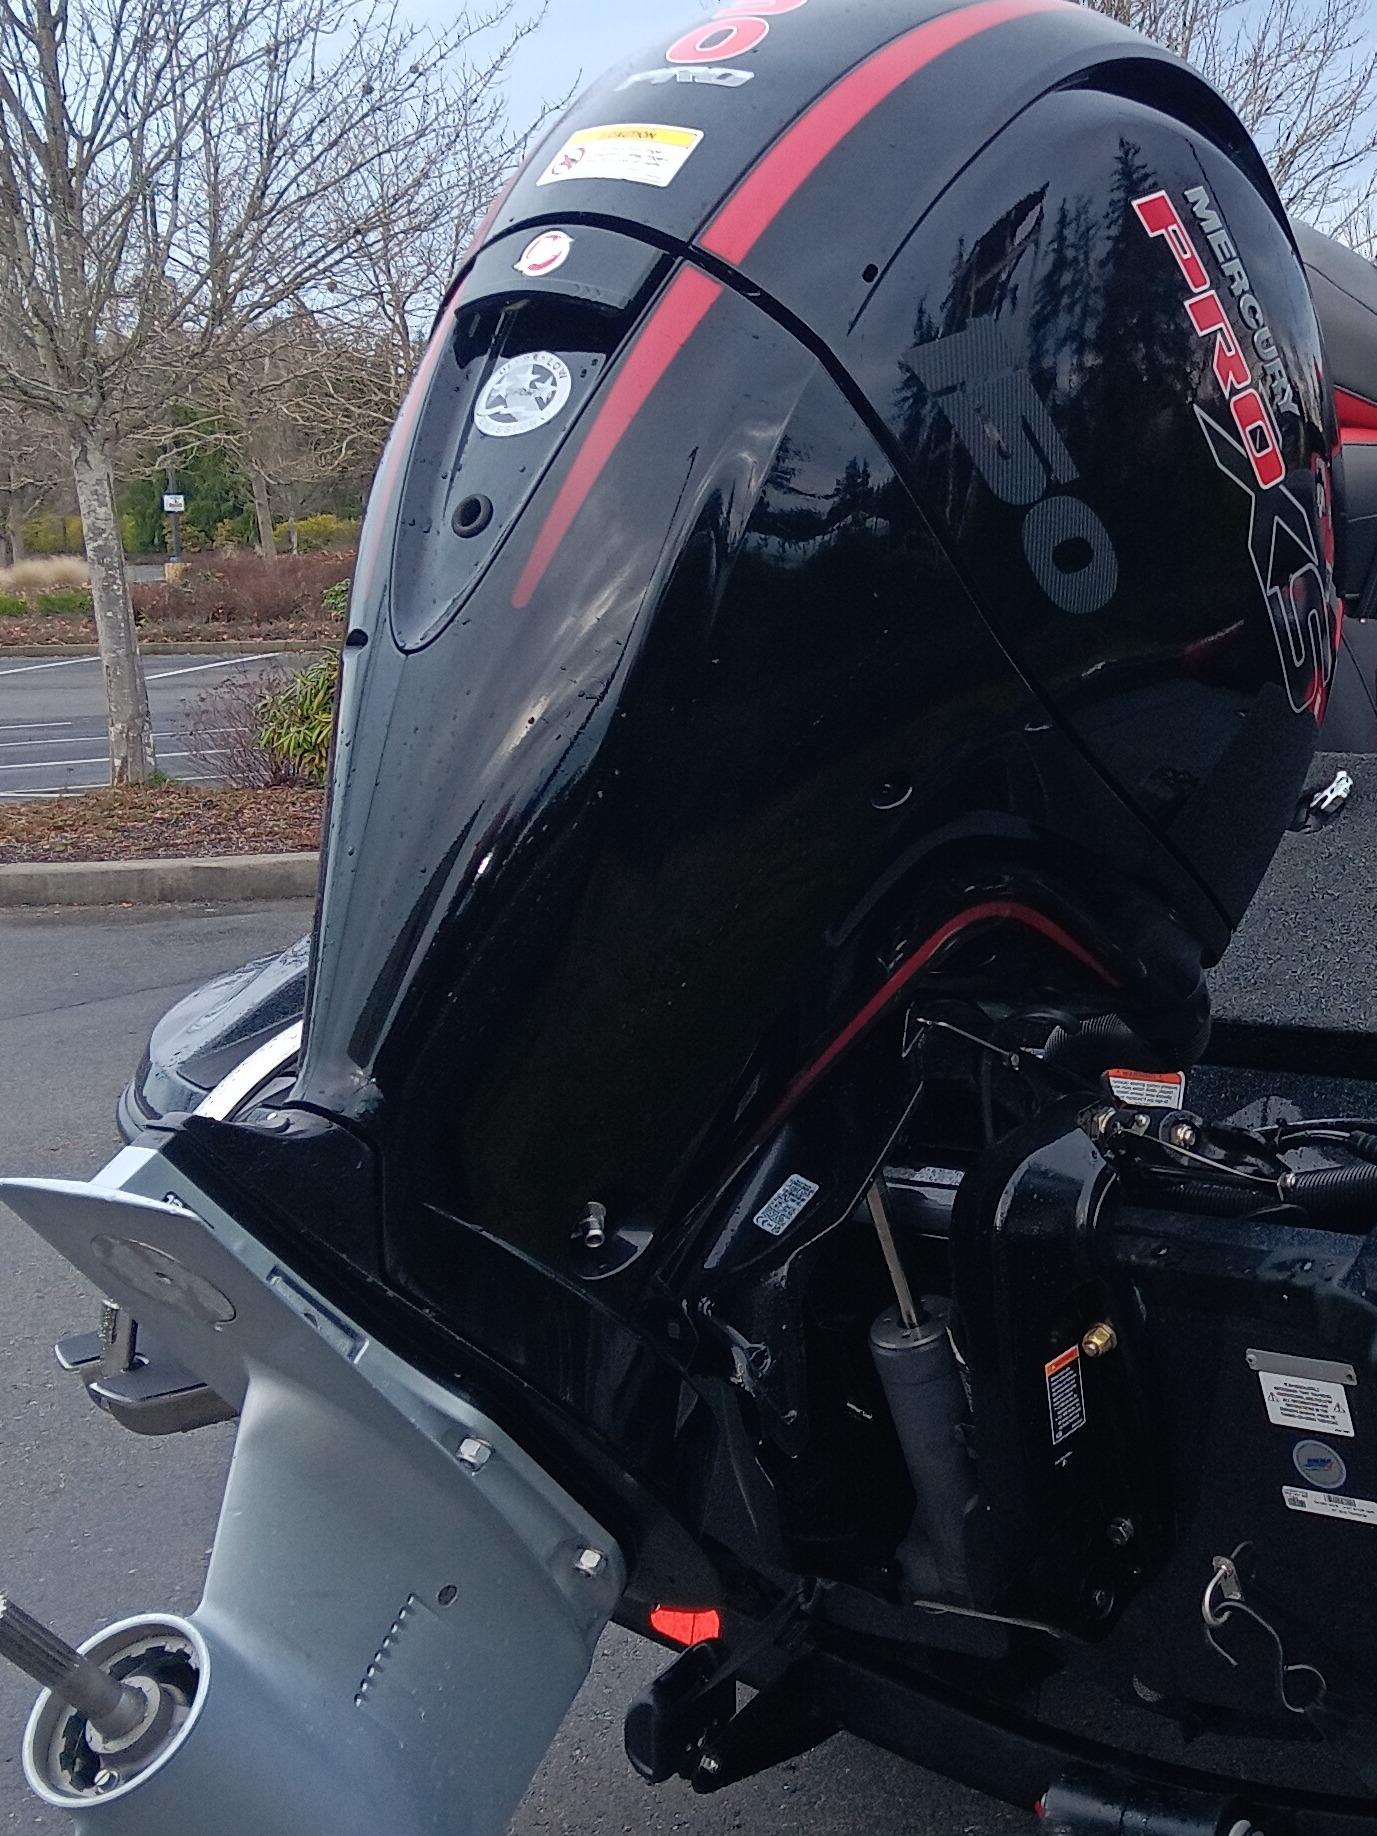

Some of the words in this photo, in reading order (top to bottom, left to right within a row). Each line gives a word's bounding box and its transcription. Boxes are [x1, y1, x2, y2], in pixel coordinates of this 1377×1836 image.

[1130, 189, 1288, 491] PRO
[1183, 184, 1300, 417] MERCURY
[901, 314, 1119, 615] 150
